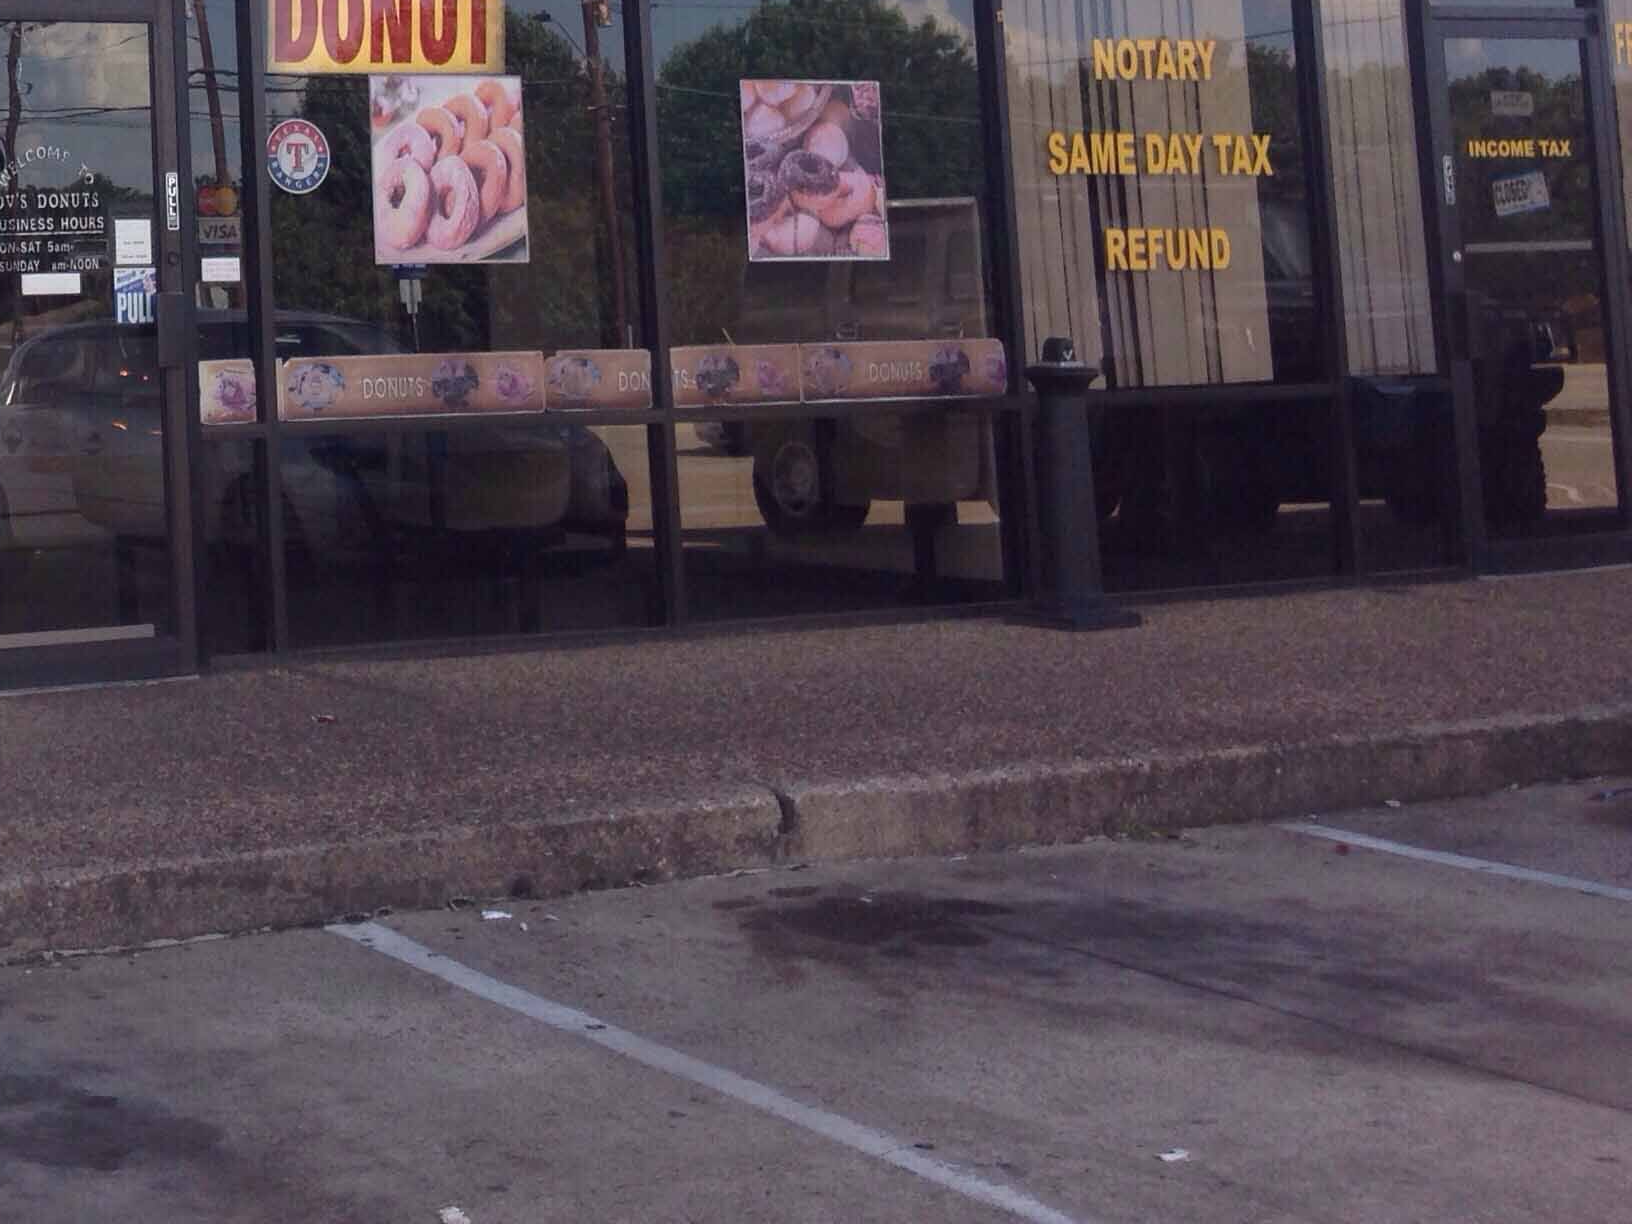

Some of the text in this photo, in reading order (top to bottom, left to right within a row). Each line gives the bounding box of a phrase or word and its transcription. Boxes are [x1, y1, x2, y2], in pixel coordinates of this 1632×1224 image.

[1093, 39, 1216, 80] NOTARY
[1048, 132, 1273, 176] SAME DAY TAX
[1468, 140, 1572, 158] INCOME TAX
[37, 192, 99, 208] DONUTS
[168, 176, 177, 217] PULL
[60, 216, 104, 230] HOURS
[204, 225, 238, 239] VISA
[1106, 228, 1231, 270] REFUND
[0, 260, 40, 272] SUNDAY
[117, 292, 155, 324] PULL
[870, 362, 922, 384] DONUTS
[362, 376, 424, 399] DONUTS
